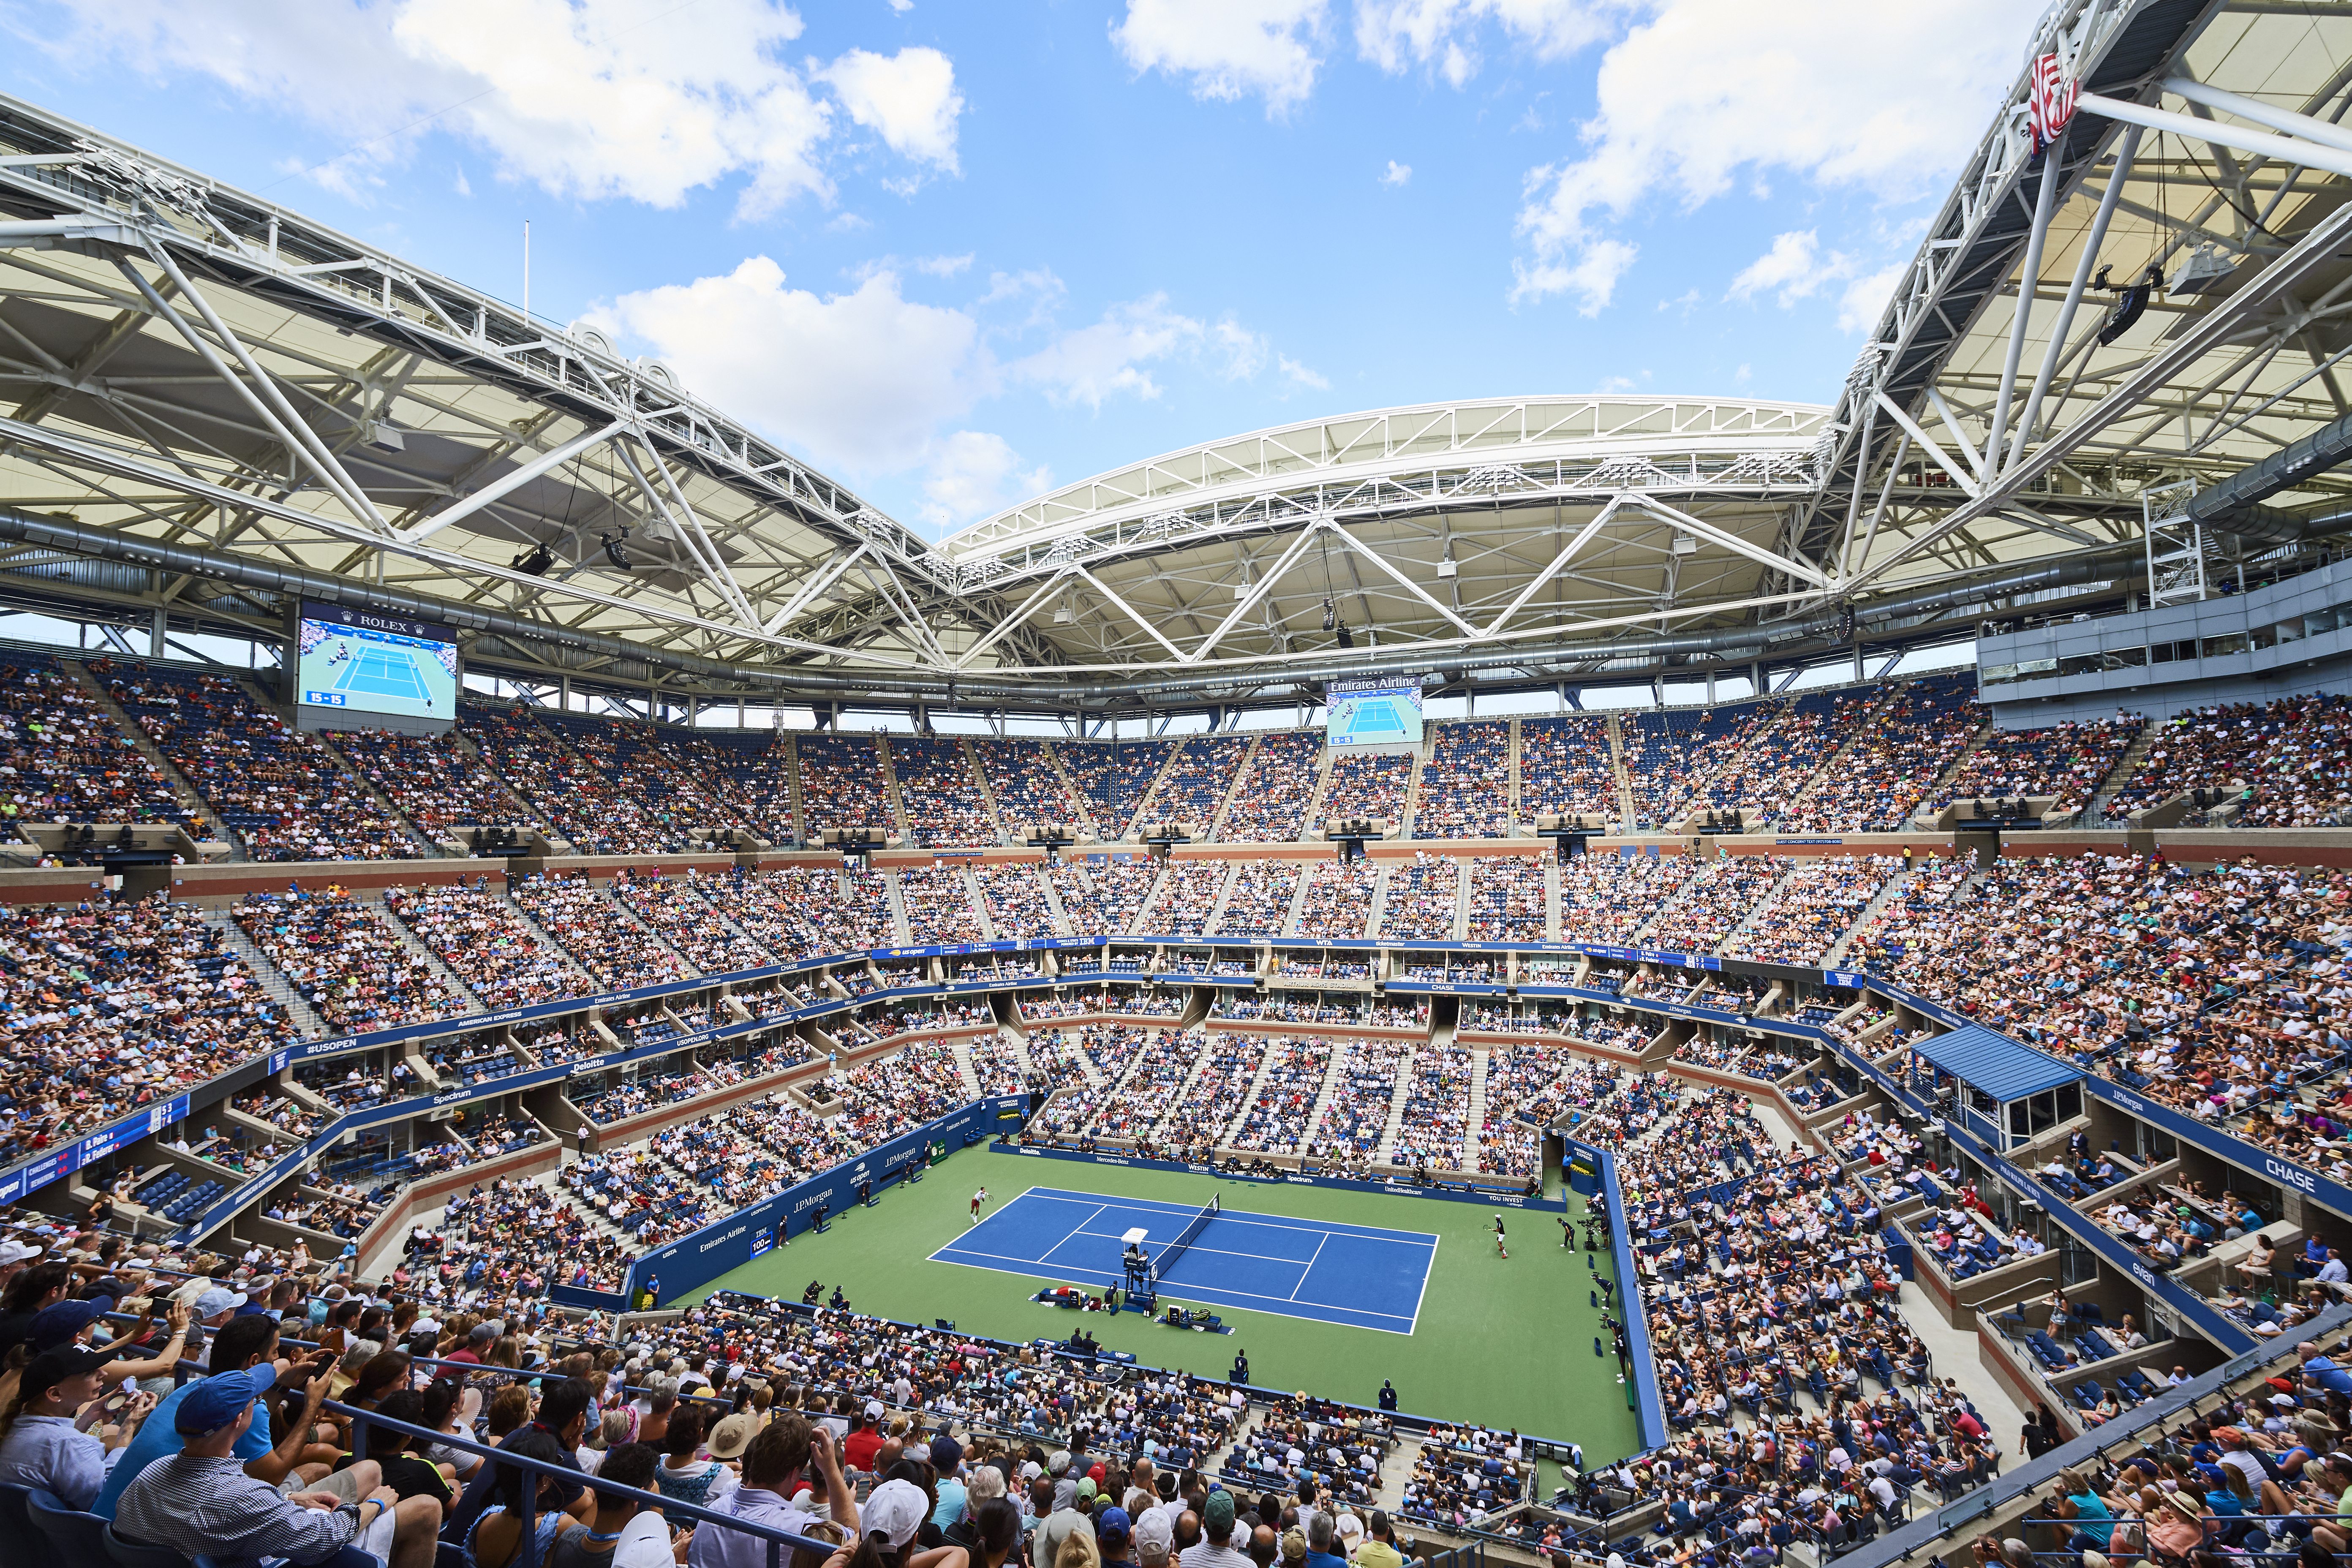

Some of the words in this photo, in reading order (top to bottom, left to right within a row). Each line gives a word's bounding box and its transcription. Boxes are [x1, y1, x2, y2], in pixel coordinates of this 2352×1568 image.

[361, 616, 407, 632] ROLEX
[1331, 680, 1376, 692] Emirates
[1379, 677, 1415, 689] Airline
[311, 693, 322, 702] 15
[331, 695, 342, 705] 15
[1079, 937, 1094, 945] IBM
[780, 963, 798, 971] CHASE
[700, 977, 721, 985] J.P.Morgan
[594, 996, 615, 1004] Emirates
[1668, 1006, 1691, 1015] J.P.Morgan
[457, 1016, 490, 1027] AMERICAN
[491, 1011, 522, 1021] EXPRESS
[768, 1014, 792, 1024] ticketmaster
[676, 1033, 709, 1047] USOPEN.ORG
[307, 1039, 357, 1054] #USOPEN
[574, 1059, 604, 1072] Deloitte
[433, 1089, 471, 1105] Spectrum
[2113, 1090, 2143, 1111] J.P.Morgan
[162, 1105, 166, 1115] 5
[167, 1103, 172, 1112] 3
[167, 1114, 172, 1124] 4
[947, 1122, 959, 1132] Emirates
[960, 1117, 971, 1126] Airline
[86, 1140, 93, 1150] B.
[93, 1134, 108, 1147] Paire
[92, 1144, 114, 1160] Federer
[1020, 1147, 1041, 1155] Deloitte.
[1574, 1147, 1592, 1157] AMERICAN
[1576, 1152, 1593, 1162] EXPRESS
[885, 1147, 916, 1168] J.P.Morgan
[1096, 1156, 1129, 1165] Mercedes-Benz
[28, 1157, 57, 1176] CHALLENGES
[30, 1171, 56, 1188] REMAINING
[857, 1169, 870, 1181] open
[1287, 1175, 1311, 1183] Spectrum
[2266, 1159, 2315, 1193] CHASE
[1384, 1186, 1422, 1195] UnitedHealthcare
[794, 1189, 833, 1214] J.P.Morgan
[751, 1203, 773, 1216] USOPEN.ORG
[700, 1235, 726, 1252] Emirates
[727, 1225, 746, 1240] Airline
[756, 1227, 767, 1238] IBM
[753, 1239, 765, 1251] 100
[663, 1248, 677, 1258] USTA
[2133, 1262, 2155, 1287] evian
[1153, 1315, 1163, 1323] POLO
[1227, 1327, 1236, 1336] POLO
